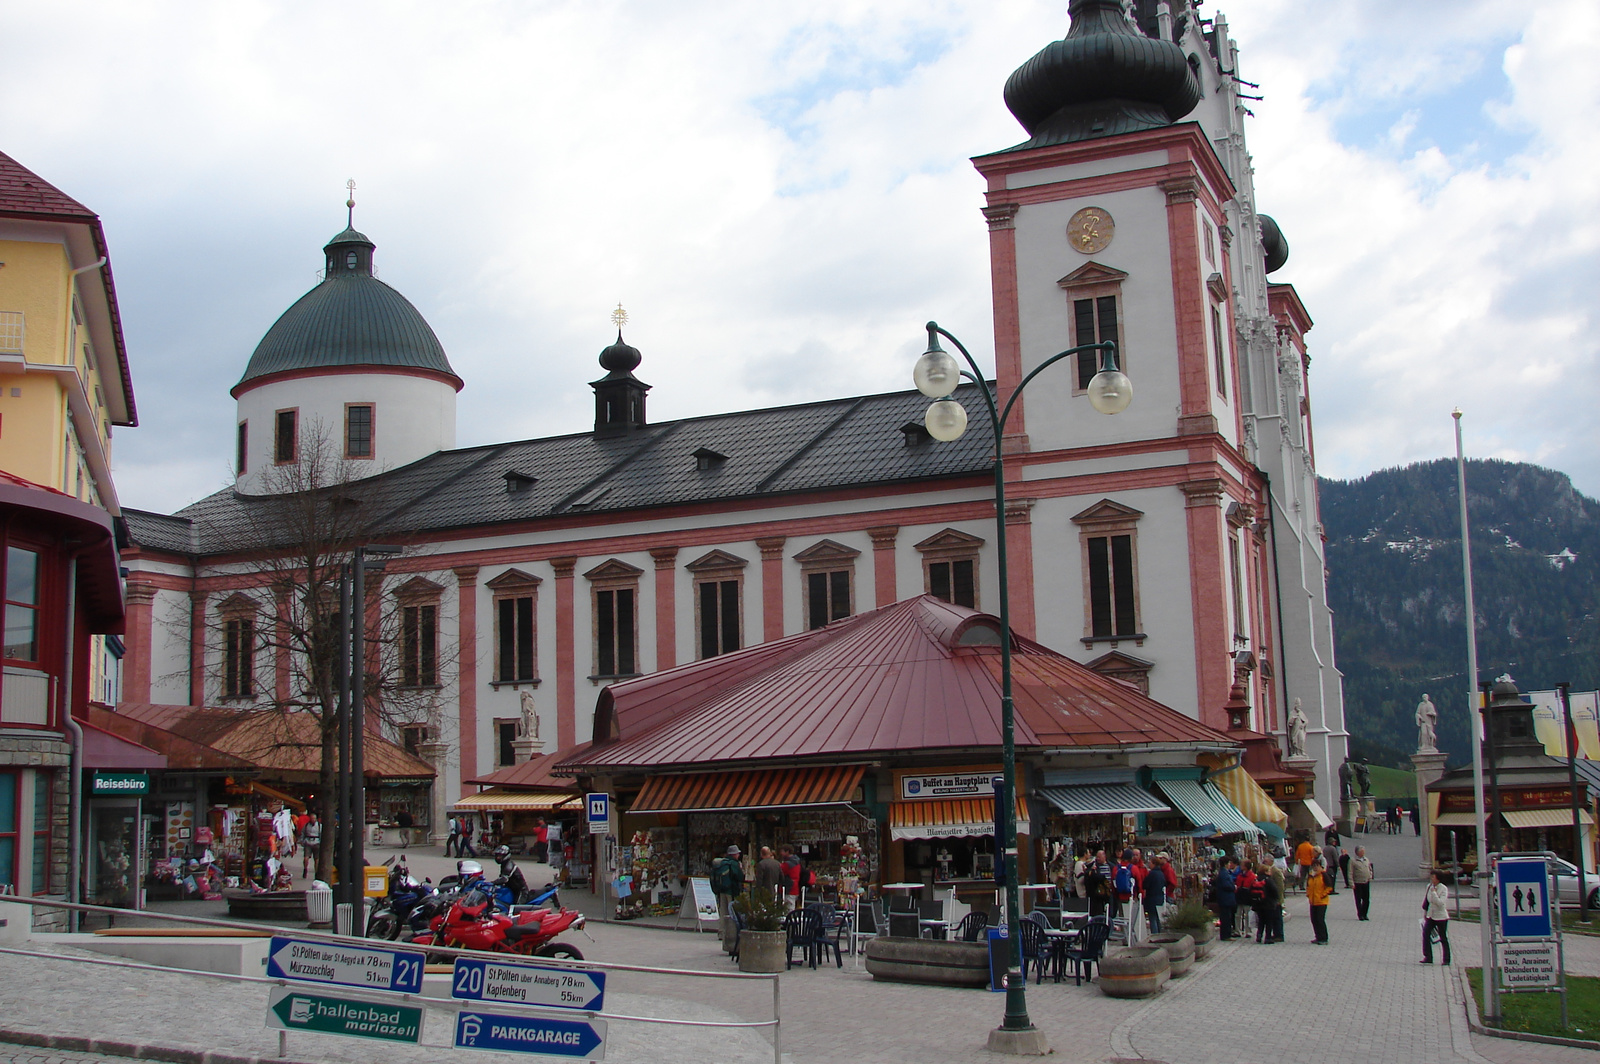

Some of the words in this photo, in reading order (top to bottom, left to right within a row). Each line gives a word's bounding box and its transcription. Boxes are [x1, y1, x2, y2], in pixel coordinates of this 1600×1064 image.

[95, 778, 146, 790] Reisebüro
[922, 778, 942, 788] Buffet
[954, 776, 990, 787] Hauptplatz
[290, 961, 335, 980] Mürzzuschlag
[396, 959, 420, 987] 21
[1503, 965, 1539, 973] Behinderte
[1540, 965, 1553, 973] und
[1508, 973, 1550, 982] Ladetätigkeit
[455, 966, 482, 993] 20
[534, 974, 560, 988] Annaberg
[487, 983, 527, 1000] Kapfenberg
[317, 1001, 400, 1024] hallenbad
[345, 1020, 416, 1037] mariazell
[491, 1025, 581, 1046] PARKGARAGE
